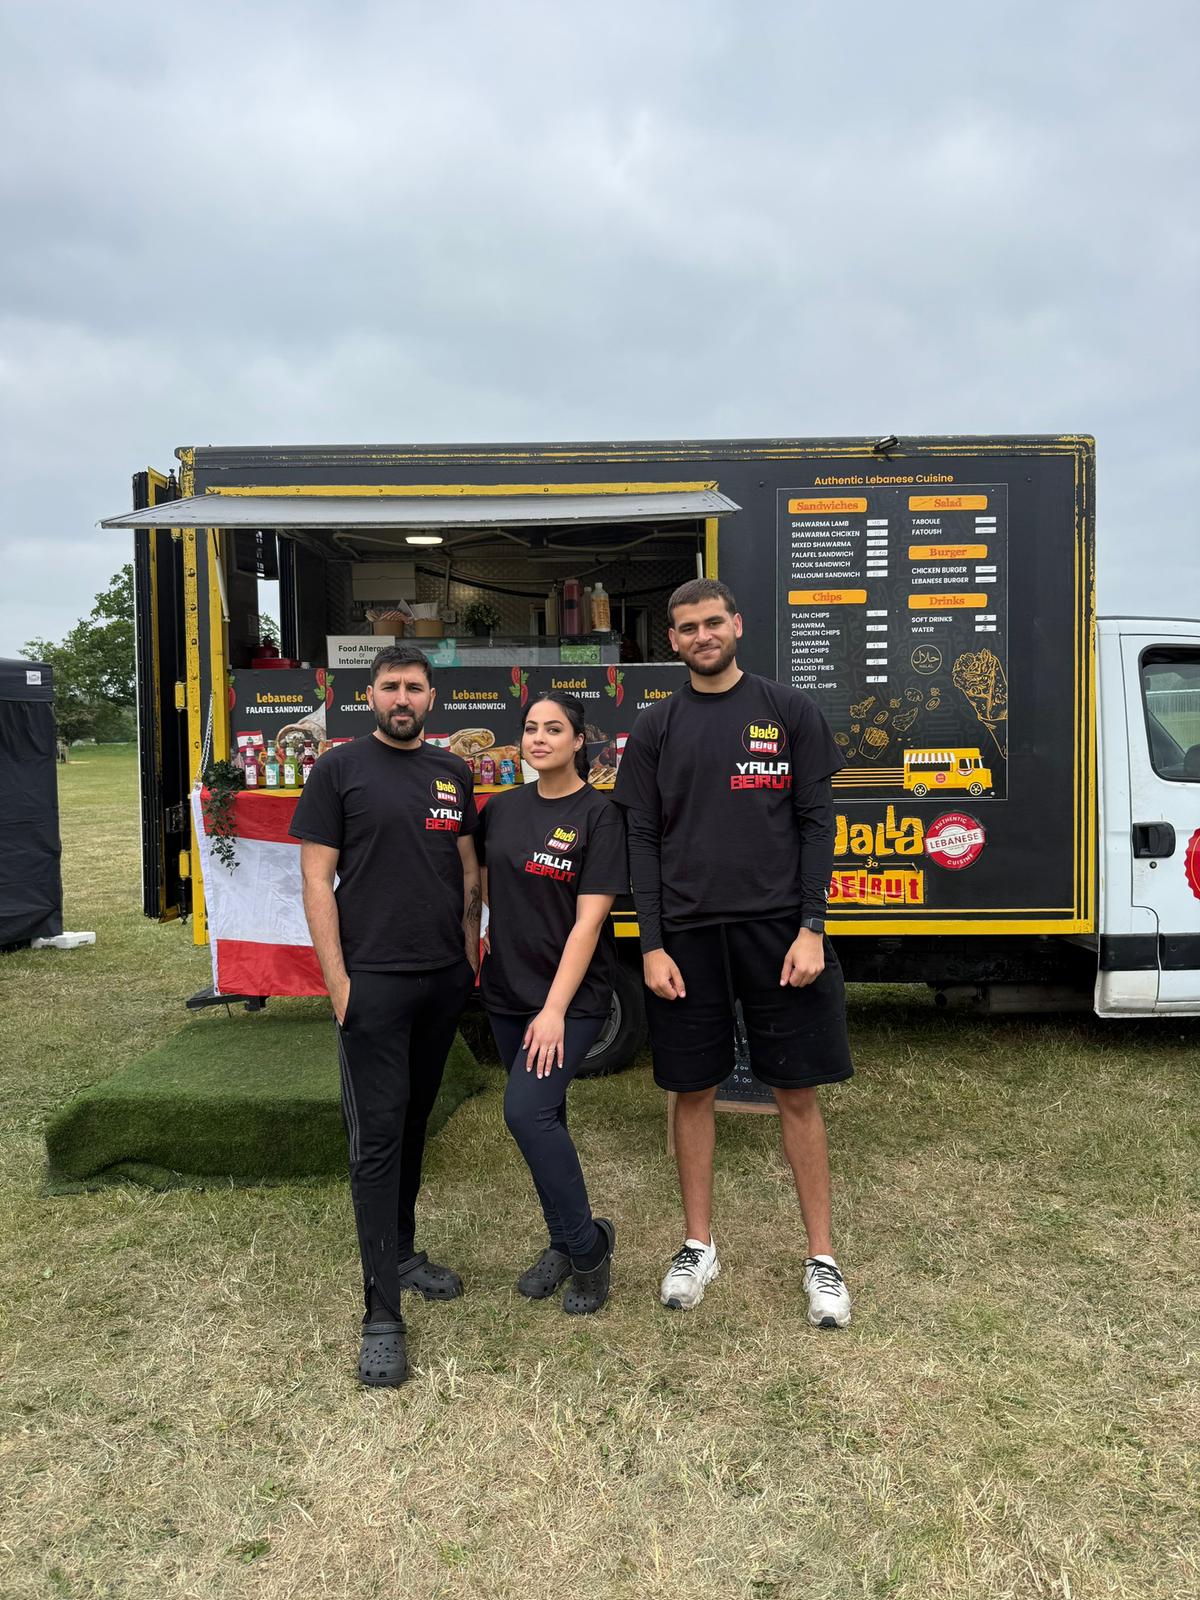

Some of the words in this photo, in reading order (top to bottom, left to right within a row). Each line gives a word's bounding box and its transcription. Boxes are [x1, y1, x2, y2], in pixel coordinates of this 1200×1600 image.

[814, 475, 863, 485] Authentic
[865, 474, 914, 484] Lebanese
[915, 473, 954, 483] Cuisine
[797, 501, 858, 511] Sandwiches
[934, 498, 962, 508] Salad
[929, 548, 967, 557] Burger
[812, 592, 842, 602] Chips
[929, 596, 965, 605] Drinks
[552, 678, 587, 689] Loaded
[256, 692, 304, 703] Lebanese
[452, 690, 499, 700] Lebanese
[246, 706, 274, 714] FALAFEL
[275, 705, 313, 713] SANDWICH
[736, 761, 789, 774] YALLA
[730, 775, 792, 790] BEIRUT
[934, 816, 968, 830] AUTHENTIC
[930, 832, 979, 849] LEBANESE
[533, 852, 572, 871] YALLA
[947, 853, 974, 866] CUISINE
[524, 861, 576, 882] BEIRUT
